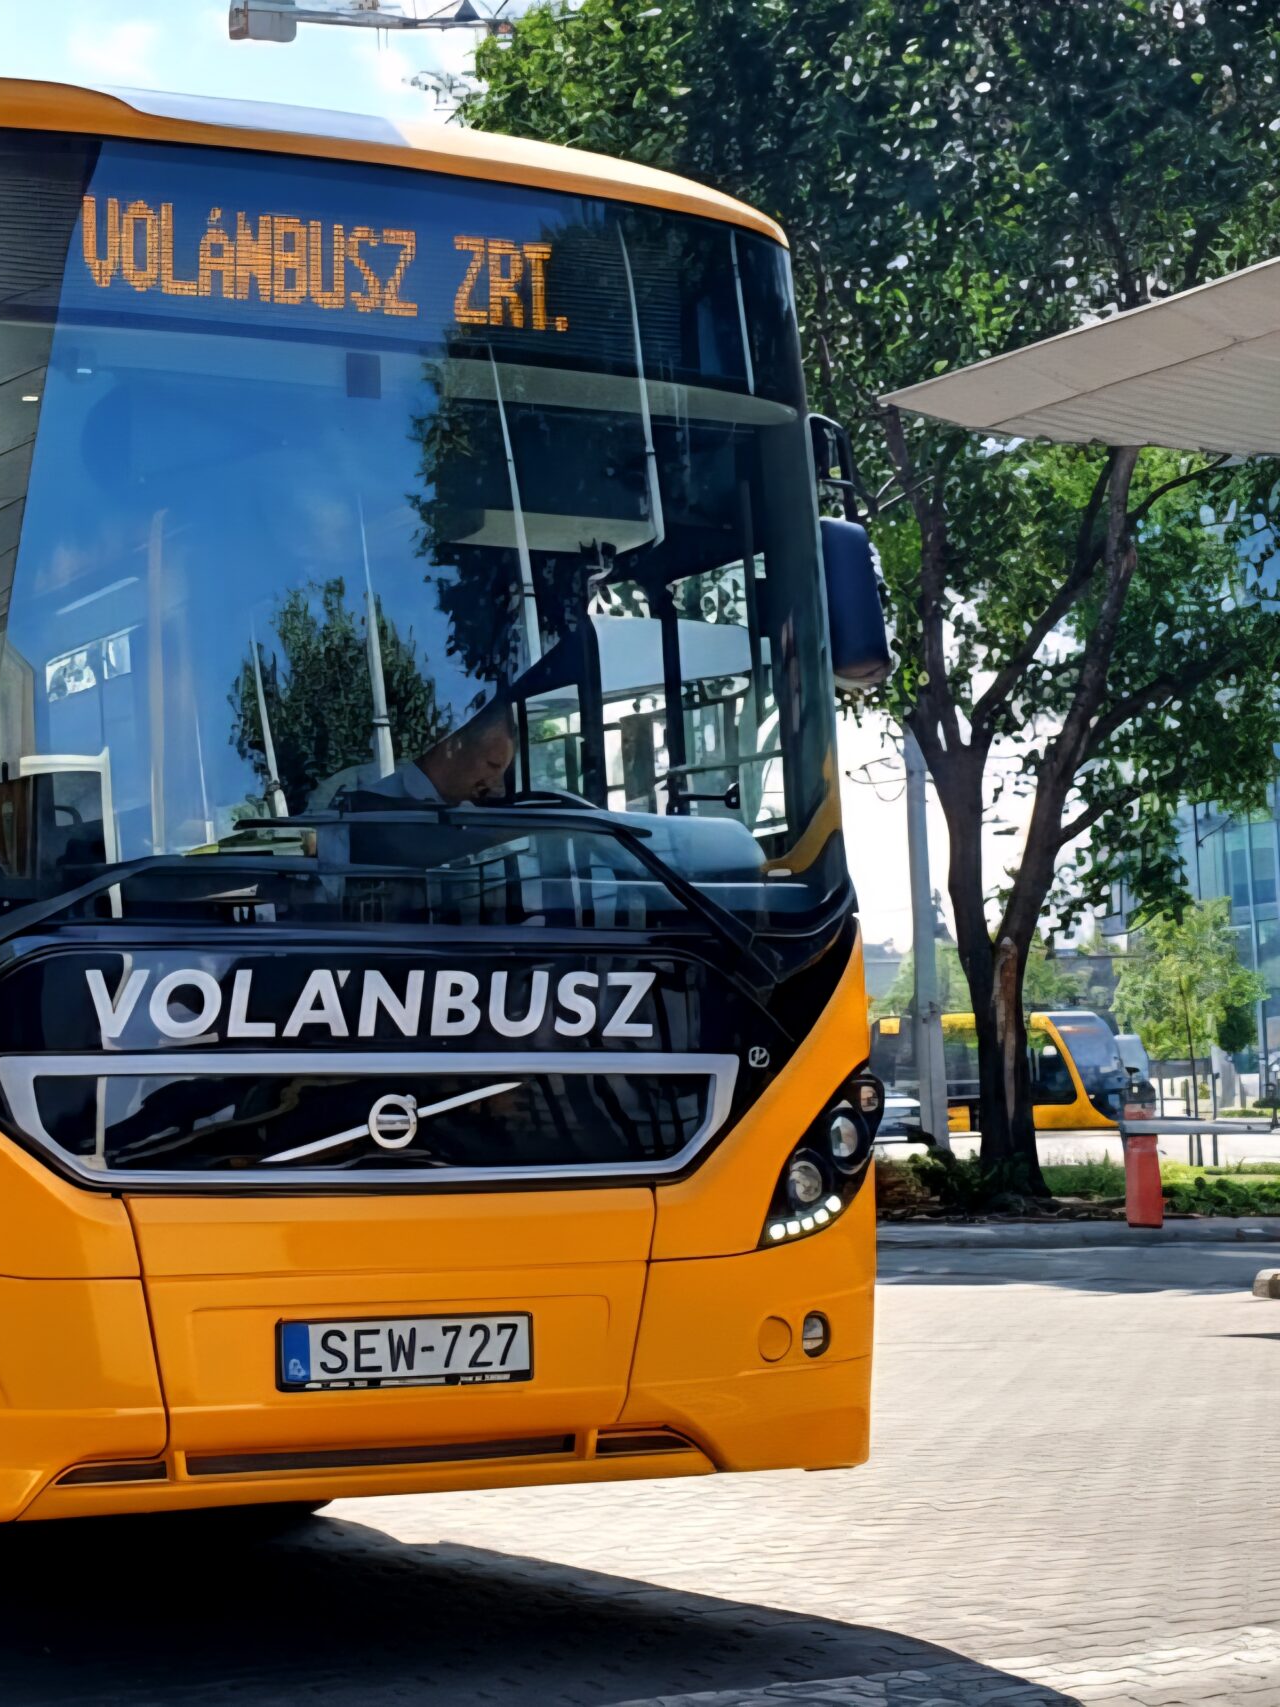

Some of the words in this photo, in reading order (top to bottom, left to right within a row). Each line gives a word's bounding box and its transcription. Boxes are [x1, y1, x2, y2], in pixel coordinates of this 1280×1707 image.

[82, 195, 418, 317] VOLÁNBUSZ
[454, 235, 569, 332] ZRT.
[85, 968, 656, 1039] VOLÁNBUSZ
[319, 1323, 519, 1375] SEW-727
